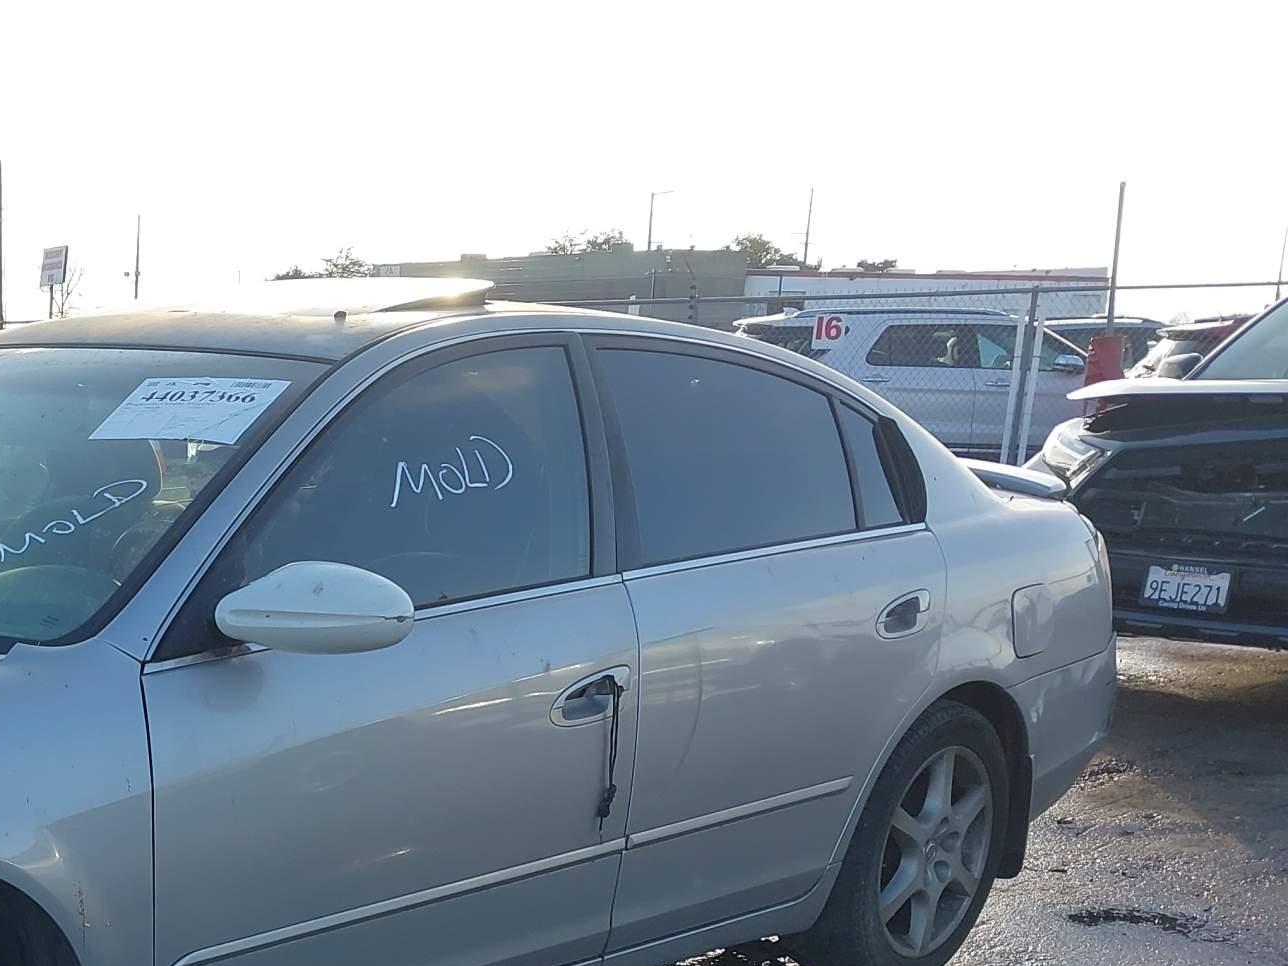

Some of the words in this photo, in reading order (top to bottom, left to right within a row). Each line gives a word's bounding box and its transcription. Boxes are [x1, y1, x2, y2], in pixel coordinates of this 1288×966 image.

[815, 316, 843, 340] 16
[141, 390, 256, 404] 44037366
[391, 435, 513, 507] MOLD
[1149, 580, 1222, 606] 9EJE271
